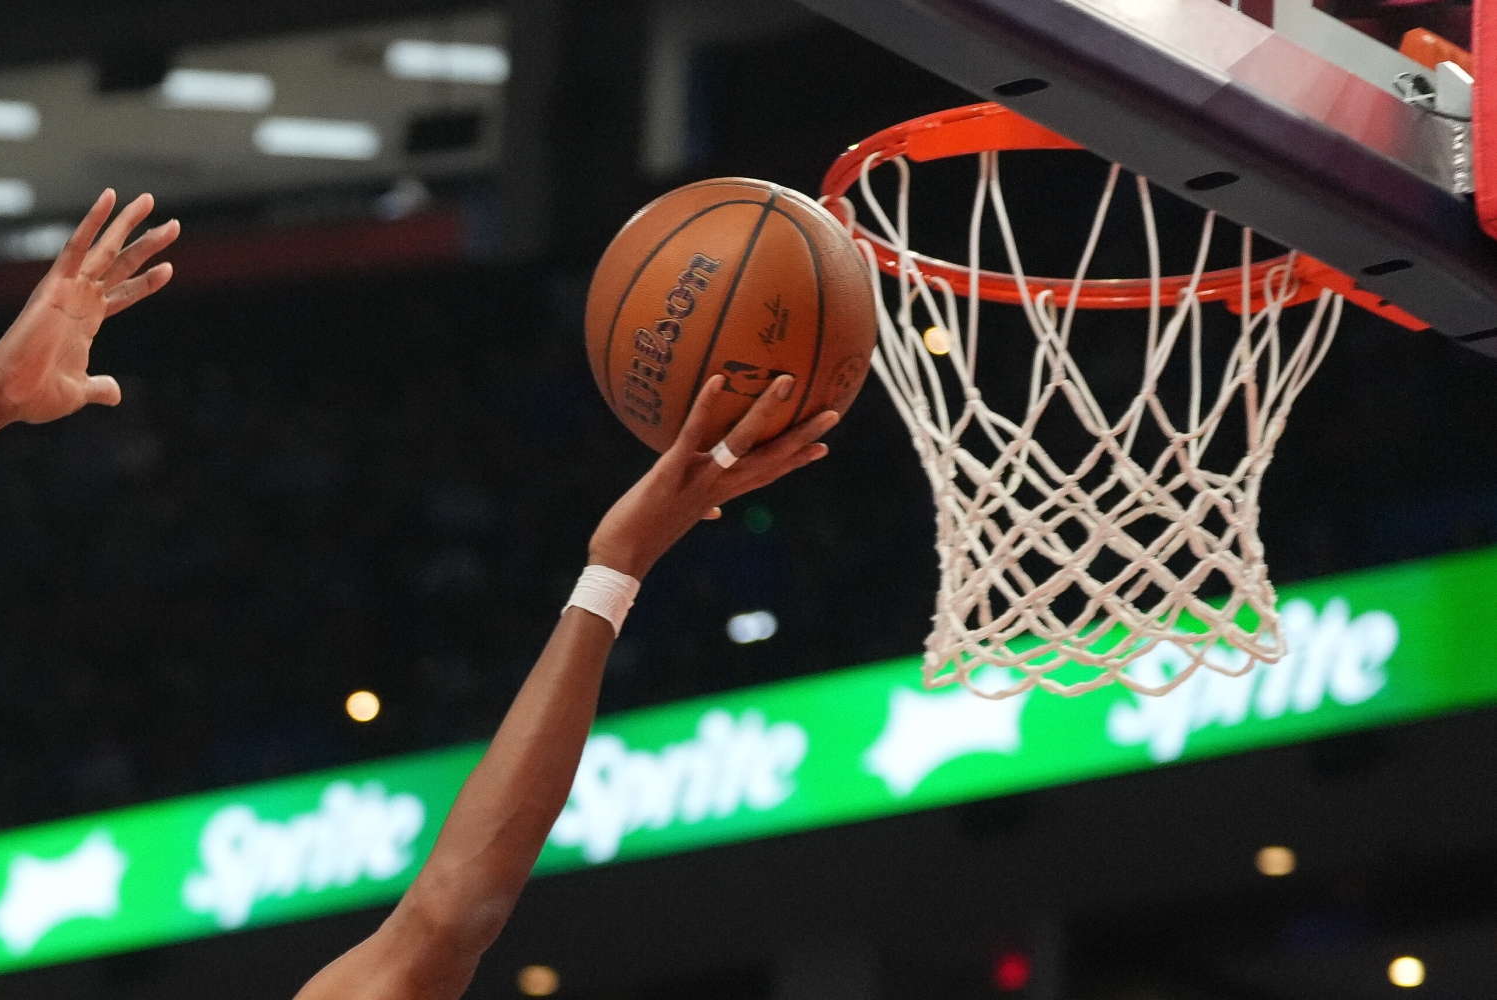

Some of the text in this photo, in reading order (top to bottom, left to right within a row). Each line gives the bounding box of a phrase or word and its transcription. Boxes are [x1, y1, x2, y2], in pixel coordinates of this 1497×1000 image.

[623, 252, 723, 426] Wilson
[182, 784, 424, 928] Sprite
[547, 712, 807, 862] Sprite
